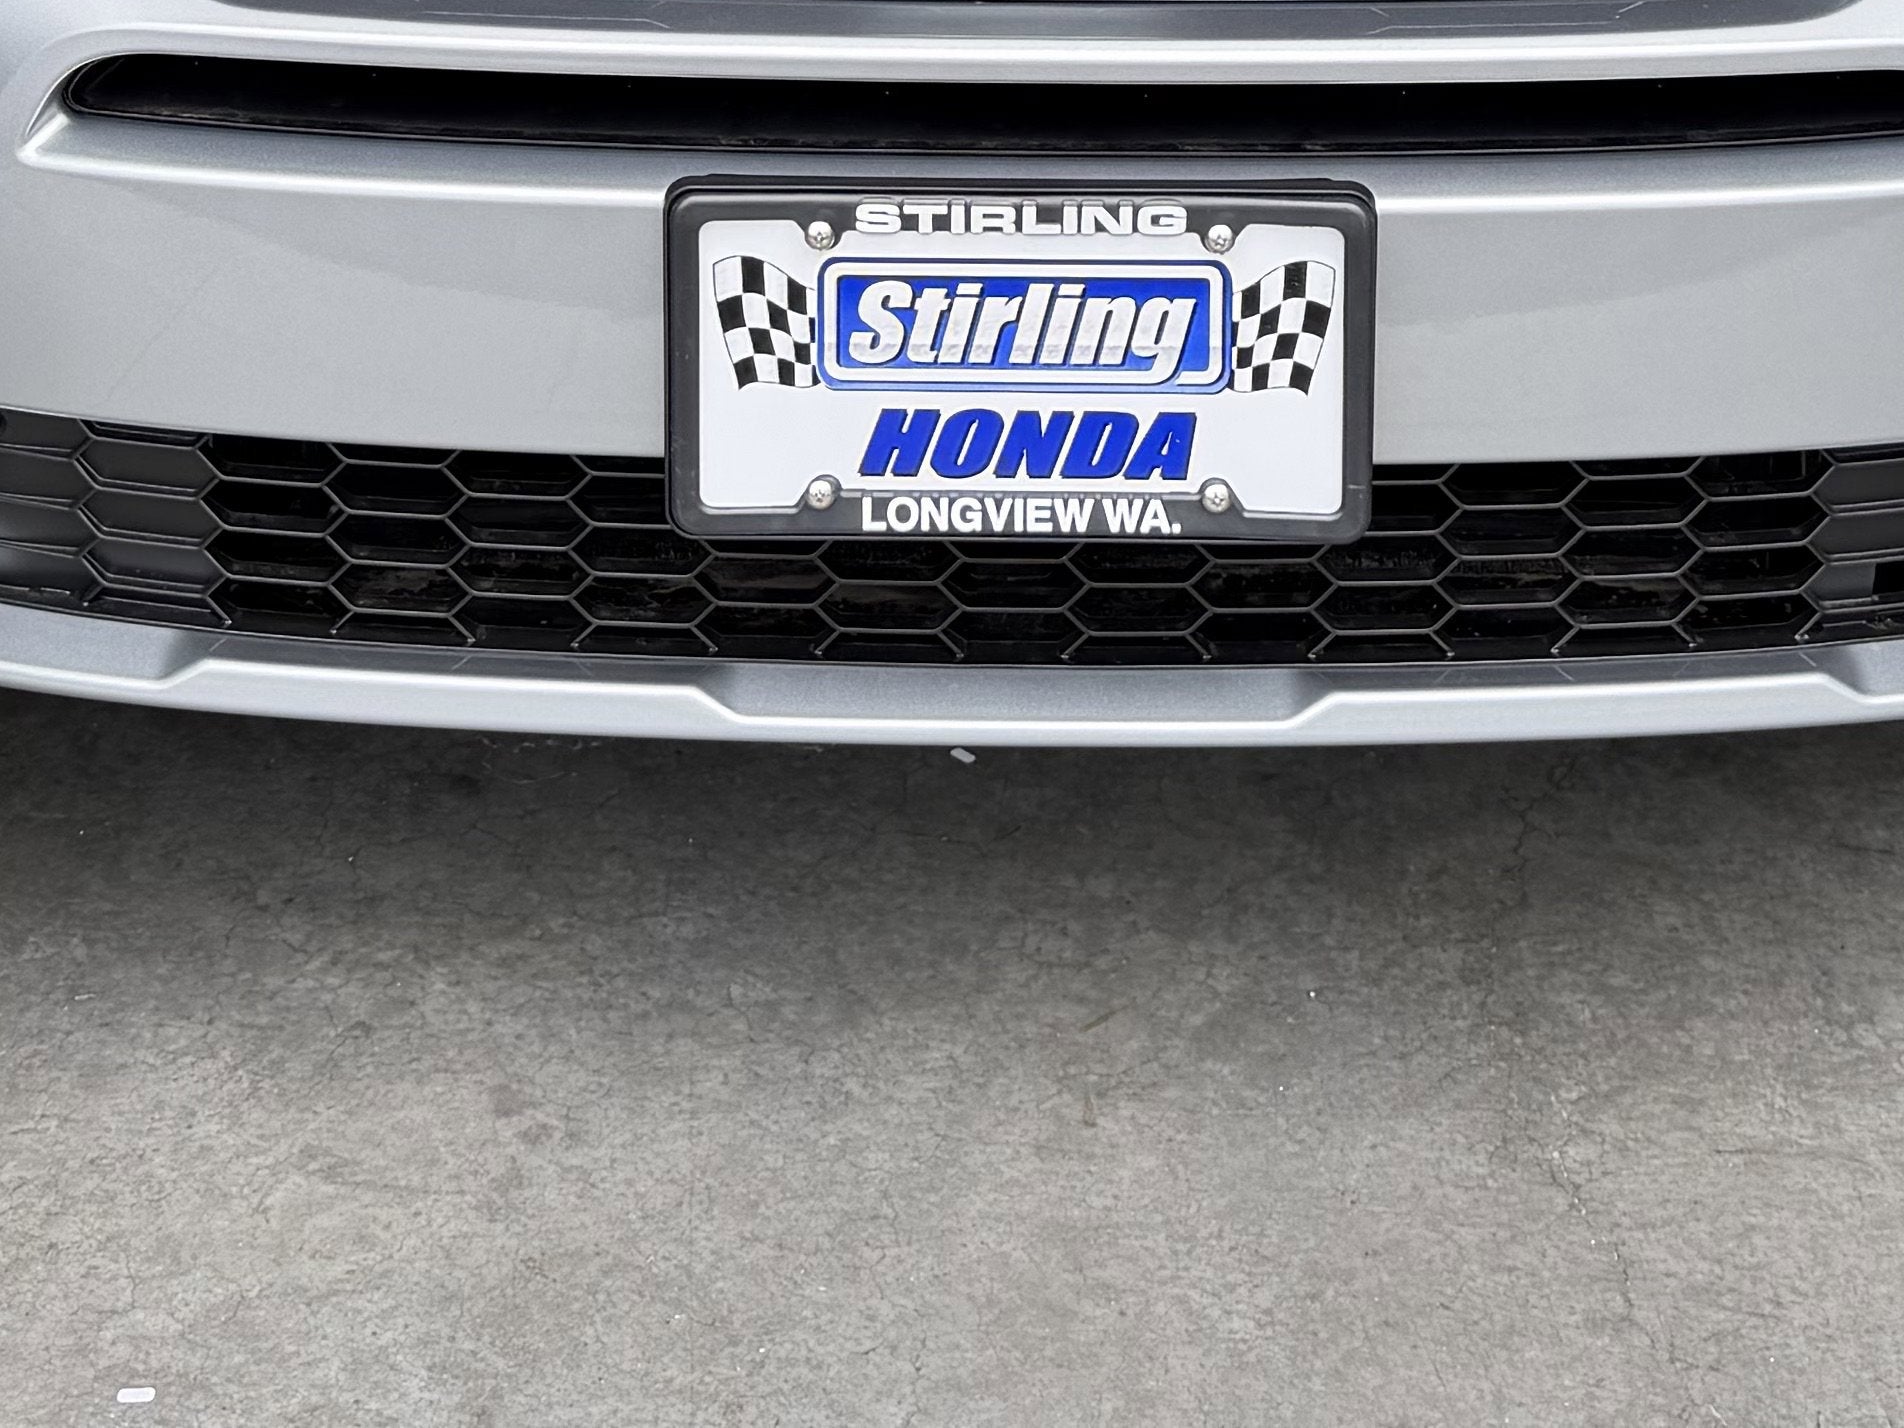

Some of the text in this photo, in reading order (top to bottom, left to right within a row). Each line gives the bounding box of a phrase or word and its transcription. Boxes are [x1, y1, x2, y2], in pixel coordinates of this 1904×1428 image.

[855, 200, 1188, 236] STIRLING
[849, 280, 1196, 383] Stirling
[858, 408, 1197, 480] HONDA
[862, 497, 1182, 534] LONGVIEW WA.
